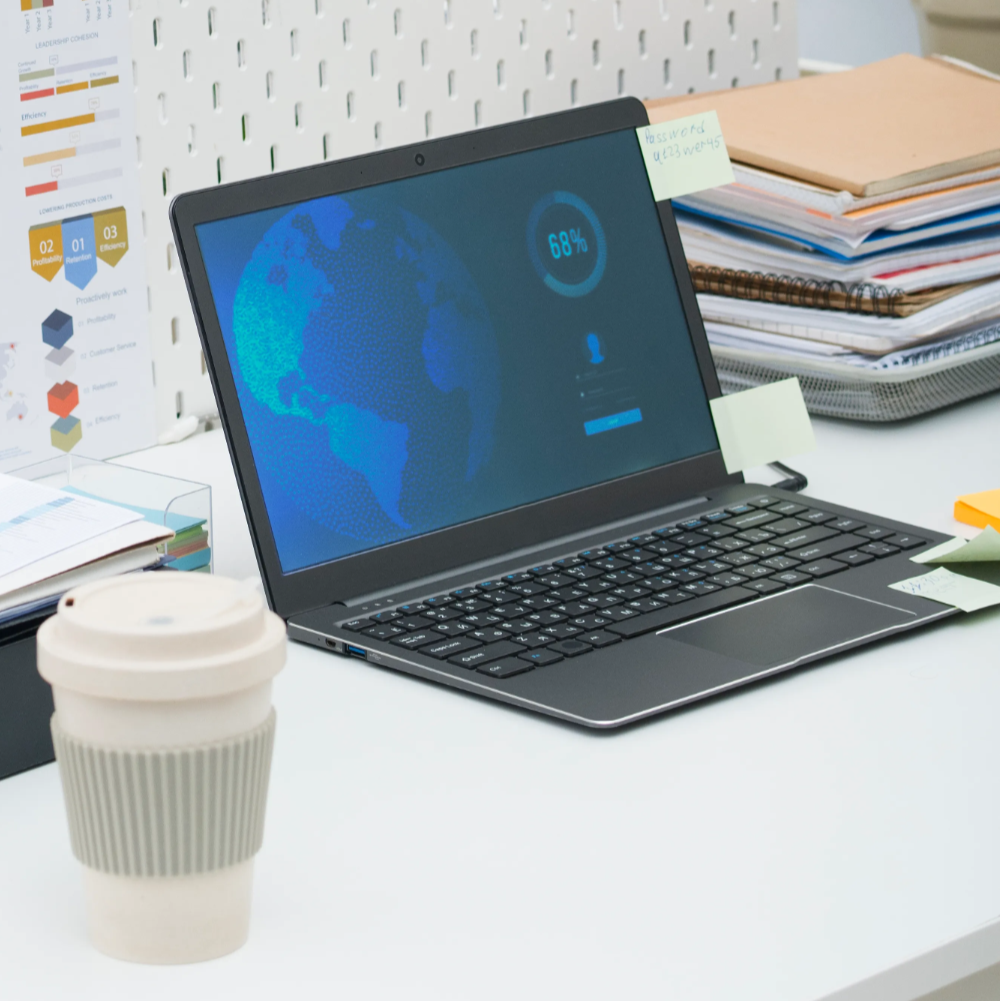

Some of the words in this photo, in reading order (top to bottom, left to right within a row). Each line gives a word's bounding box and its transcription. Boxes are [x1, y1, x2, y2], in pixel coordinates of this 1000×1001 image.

[35, 34, 70, 49] LEADERSHIP
[70, 32, 99, 43] COHESION
[21, 110, 47, 122] Efficiency
[39, 204, 65, 215] LOWERING
[66, 198, 96, 209] PRODUCTION
[97, 194, 113, 203] COSTS
[103, 225, 118, 240] 03
[39, 239, 54, 254] 02
[71, 238, 85, 252] 01
[100, 242, 126, 253] Efficiency
[547, 227, 588, 260] 68%
[32, 254, 63, 267] Profitability
[65, 253, 92, 264] Retention
[76, 291, 112, 306] Proactively
[112, 288, 128, 297] work
[86, 312, 116, 325] Profitability
[89, 346, 116, 358] Customer
[116, 341, 137, 352] Service
[92, 380, 118, 392] Retention
[94, 412, 121, 425] Efficiency
